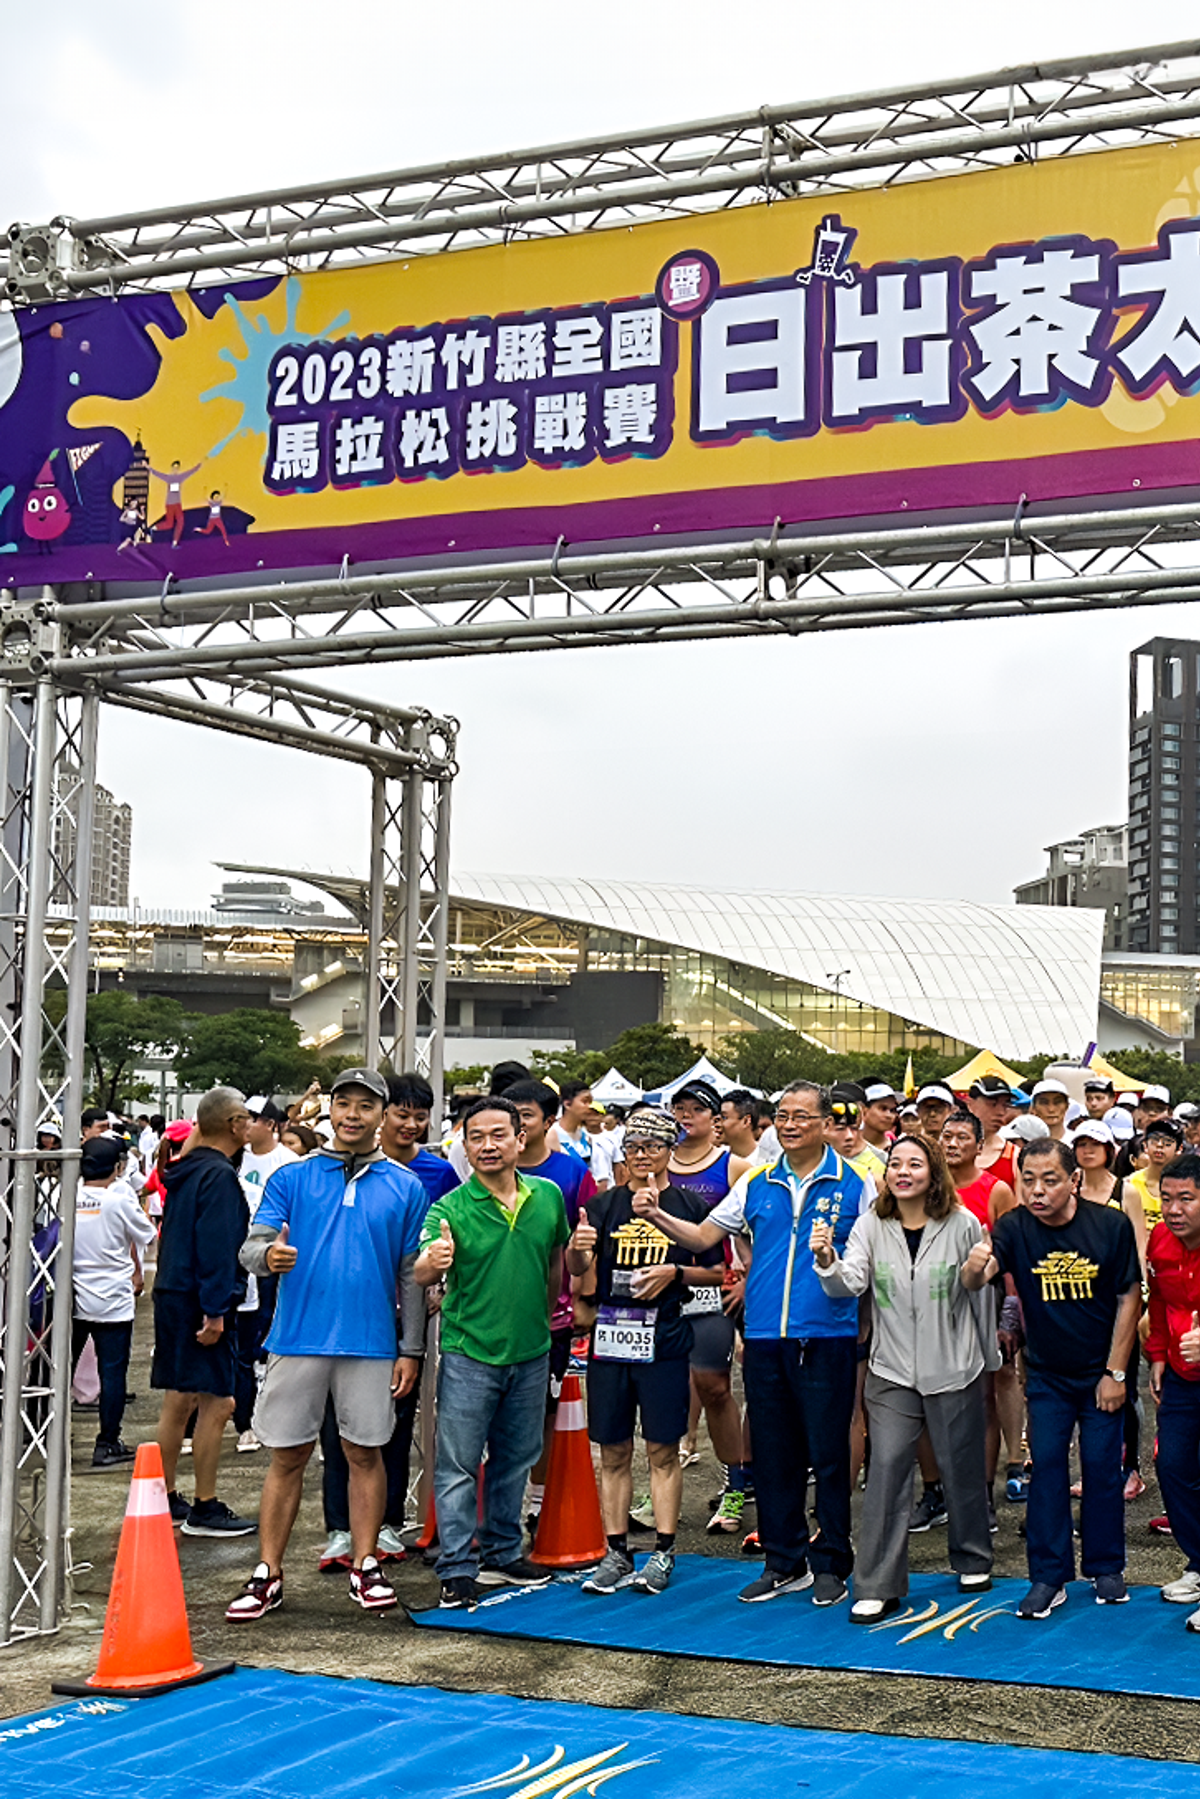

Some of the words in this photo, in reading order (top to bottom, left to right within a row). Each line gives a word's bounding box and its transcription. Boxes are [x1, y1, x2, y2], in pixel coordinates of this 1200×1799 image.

[668, 263, 702, 306] 暨
[275, 307, 662, 407] 2023新竹縣全國
[271, 384, 657, 481] 馬拉松挑戰賽
[695, 1287, 718, 1300] 023
[610, 1330, 651, 1344] 10035
